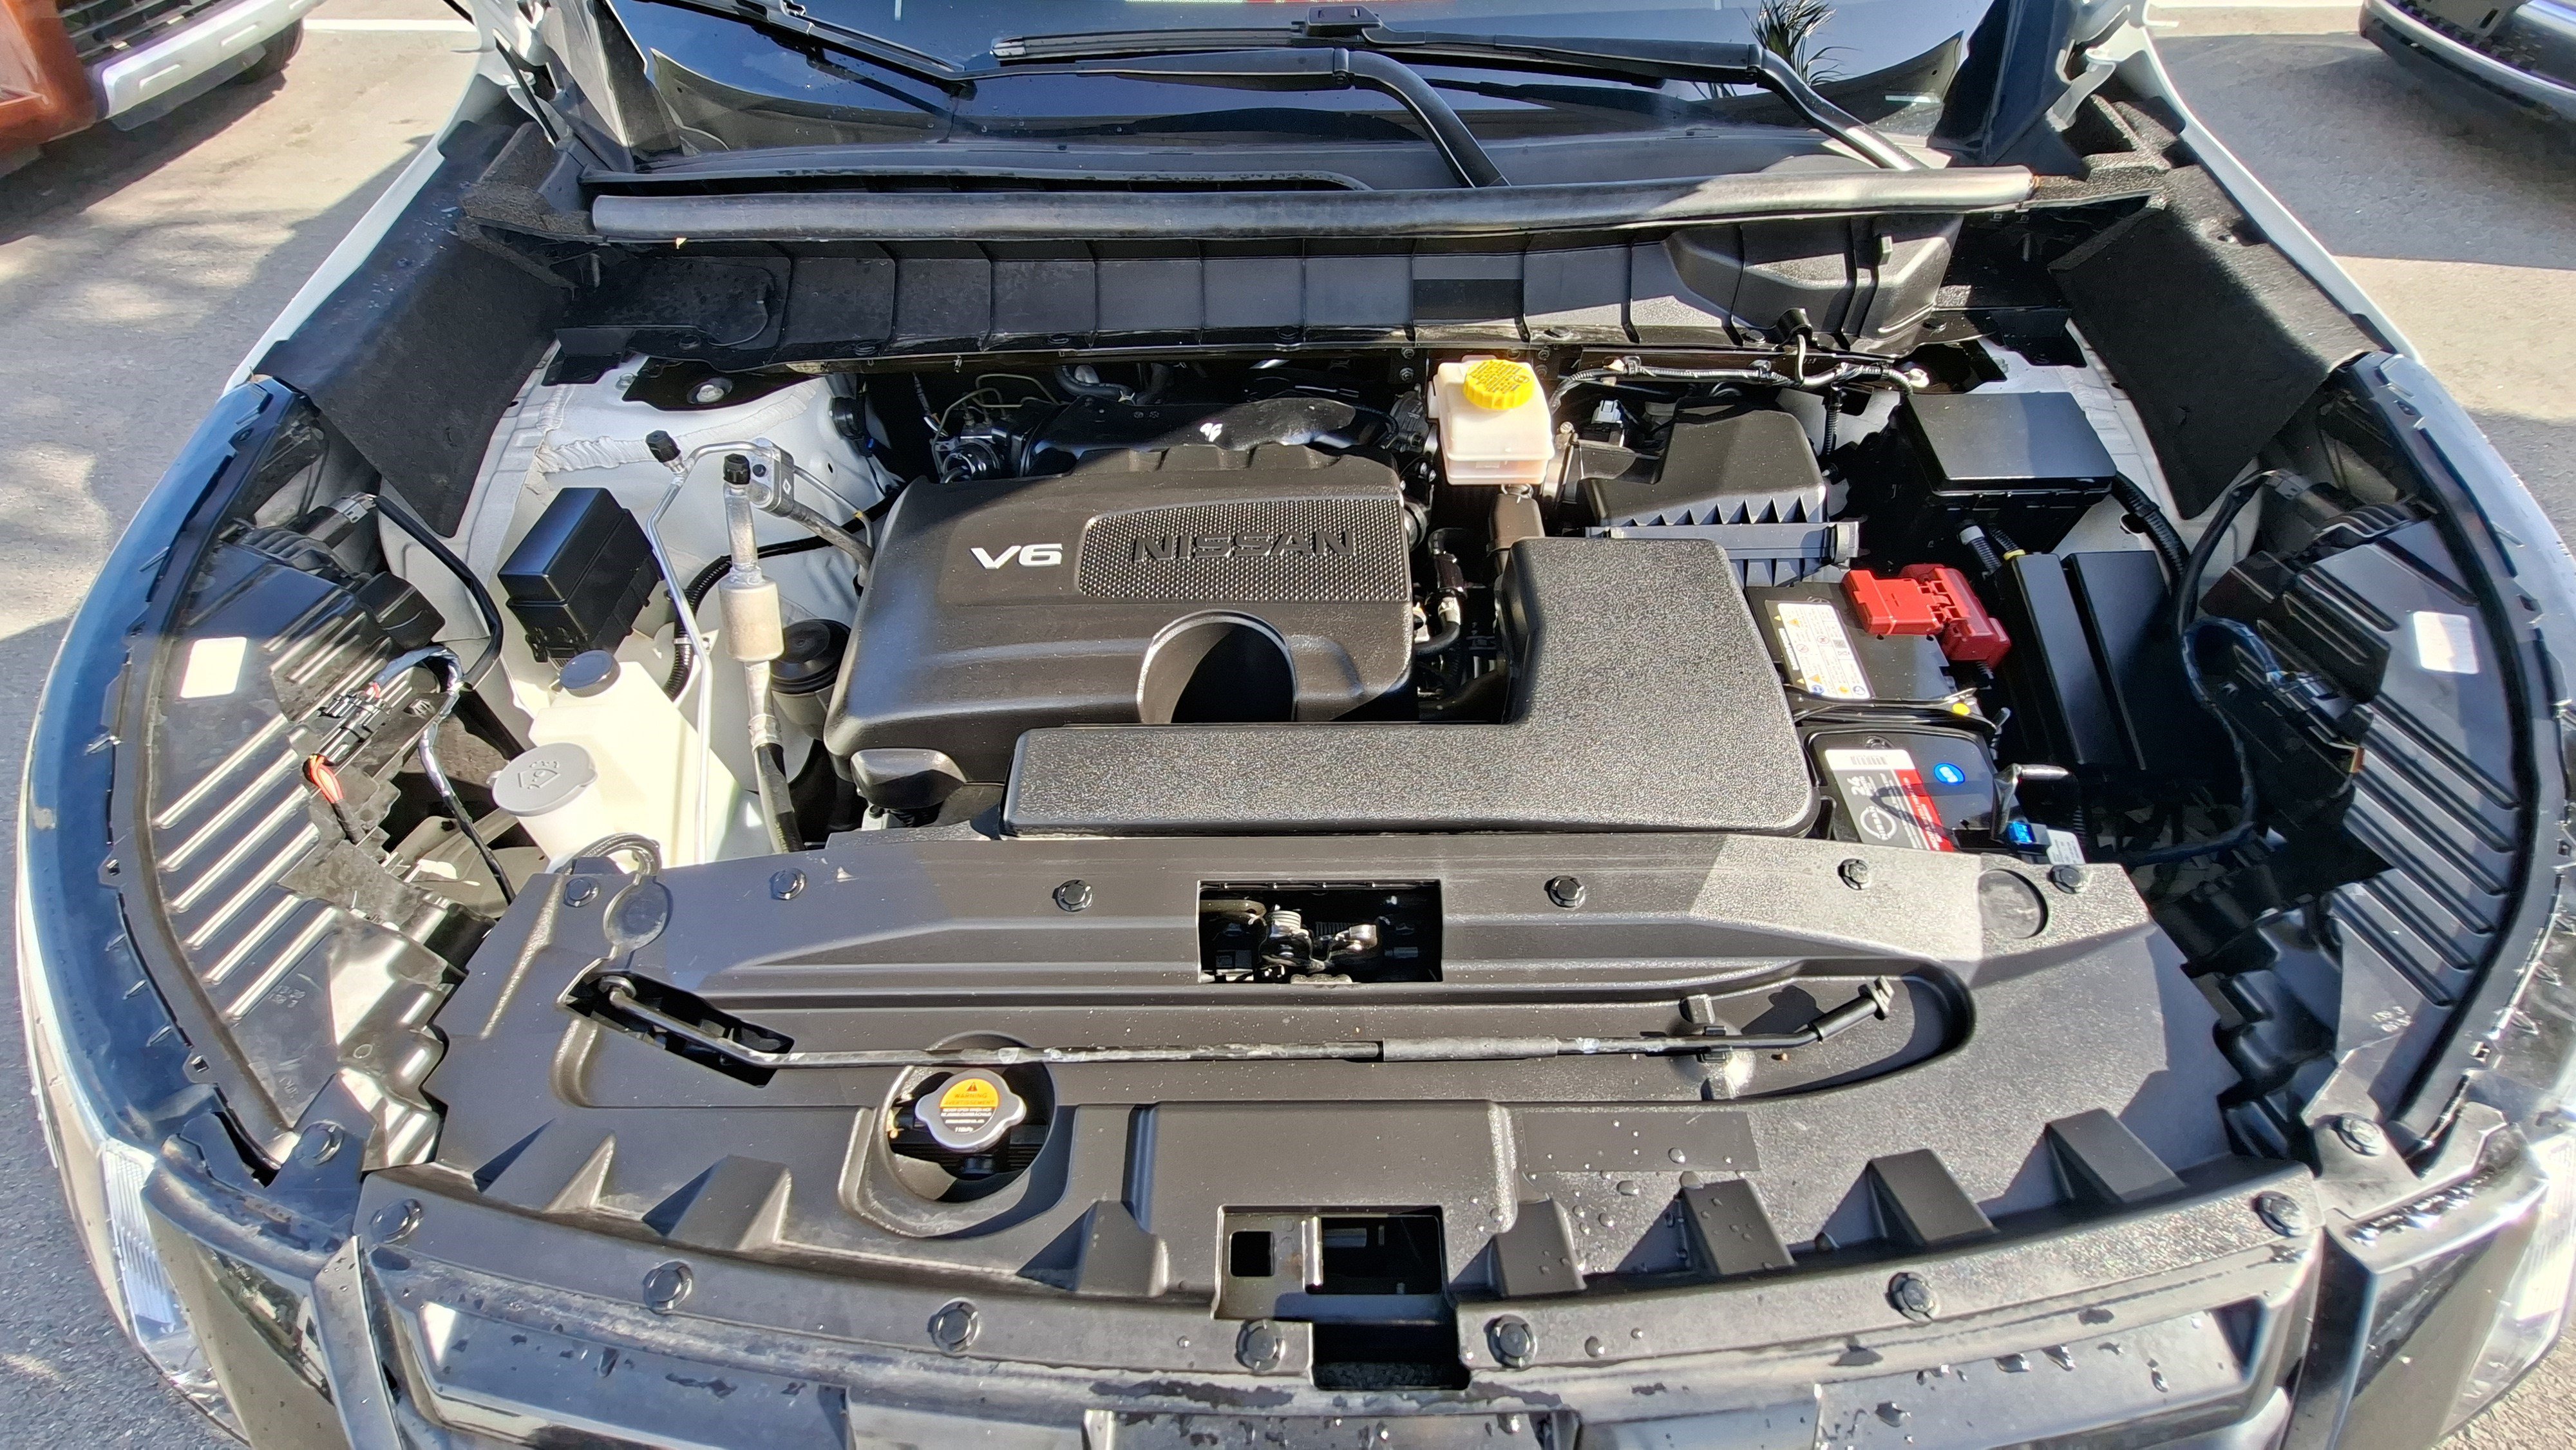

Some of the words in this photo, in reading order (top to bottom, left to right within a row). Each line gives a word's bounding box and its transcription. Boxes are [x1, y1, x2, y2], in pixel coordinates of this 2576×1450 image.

[970, 543, 1063, 569] V6
[1133, 531, 1353, 563] NISSAN
[1868, 805, 1889, 841] NISSAN
